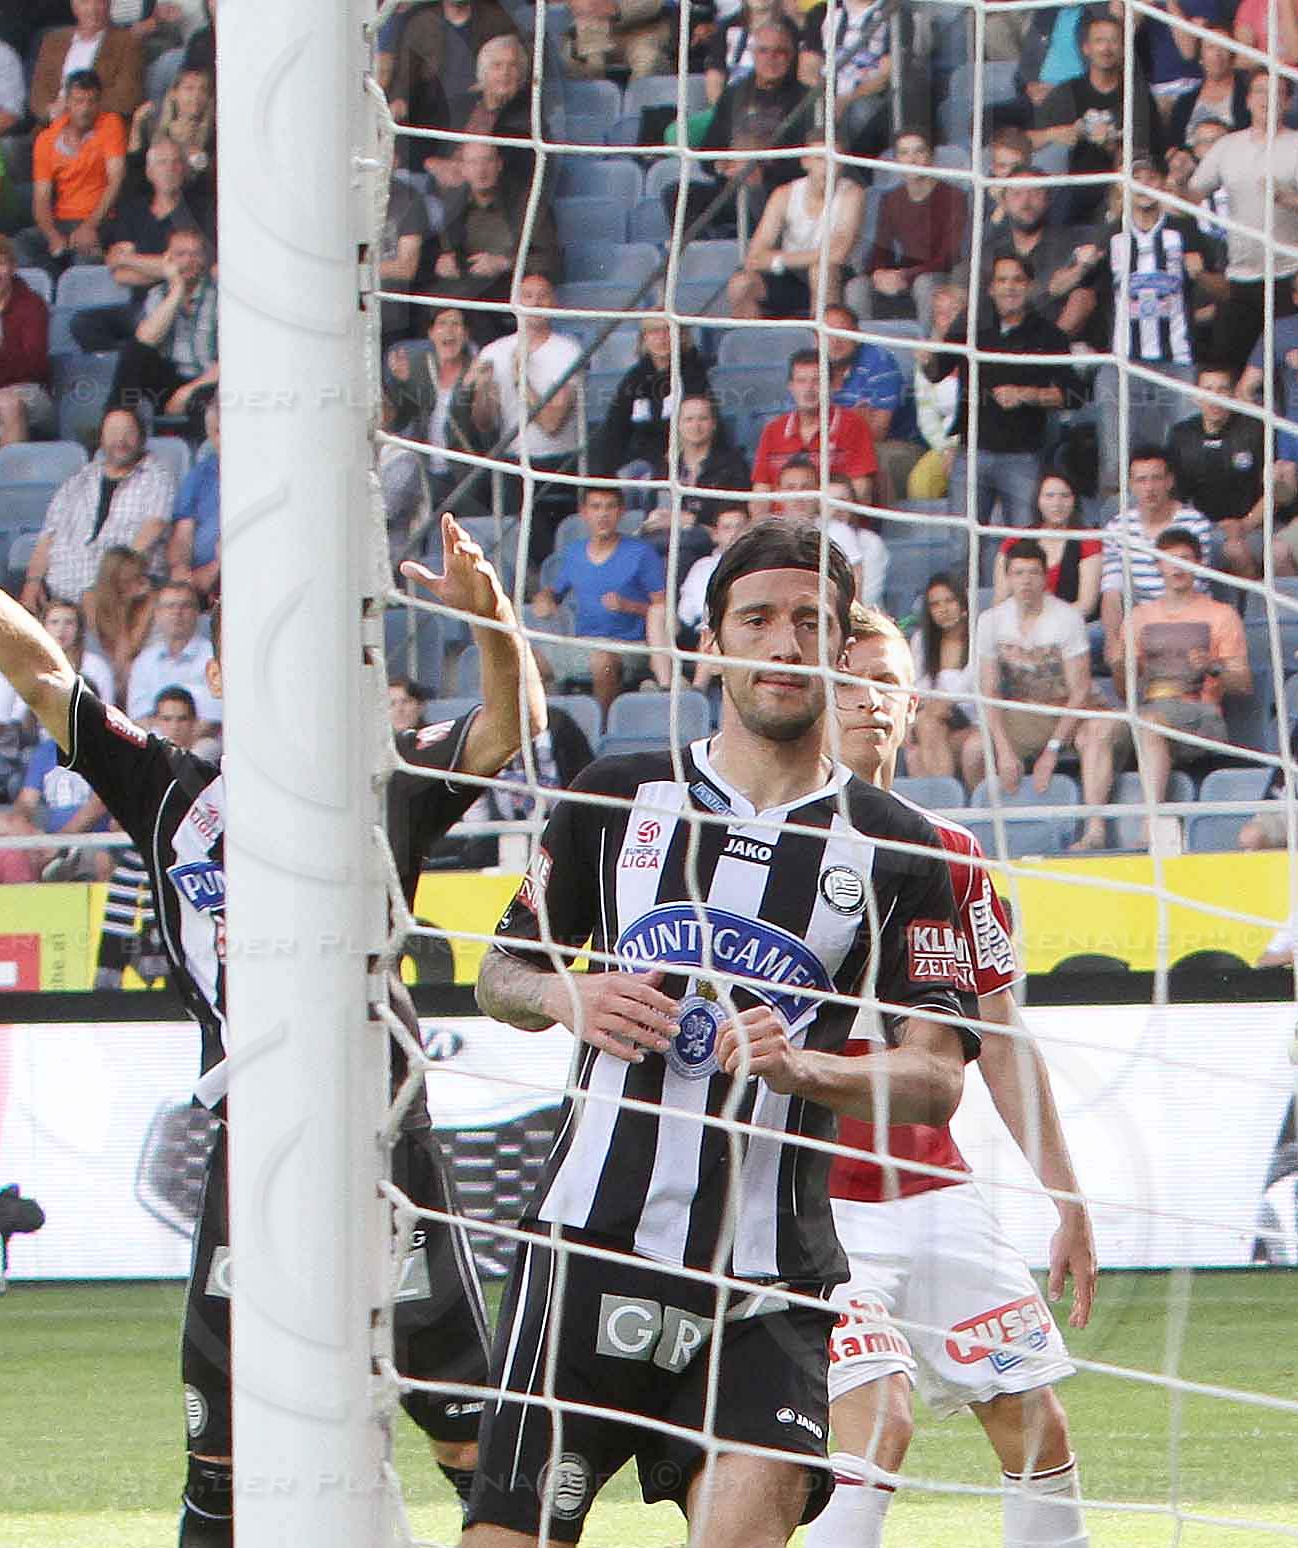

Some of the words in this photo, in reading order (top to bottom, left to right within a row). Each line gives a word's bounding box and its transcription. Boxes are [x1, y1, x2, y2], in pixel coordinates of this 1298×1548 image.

[724, 838, 773, 861] JAKO
[621, 854, 660, 869] LIGA
[797, 1413, 824, 1440] JAKO
